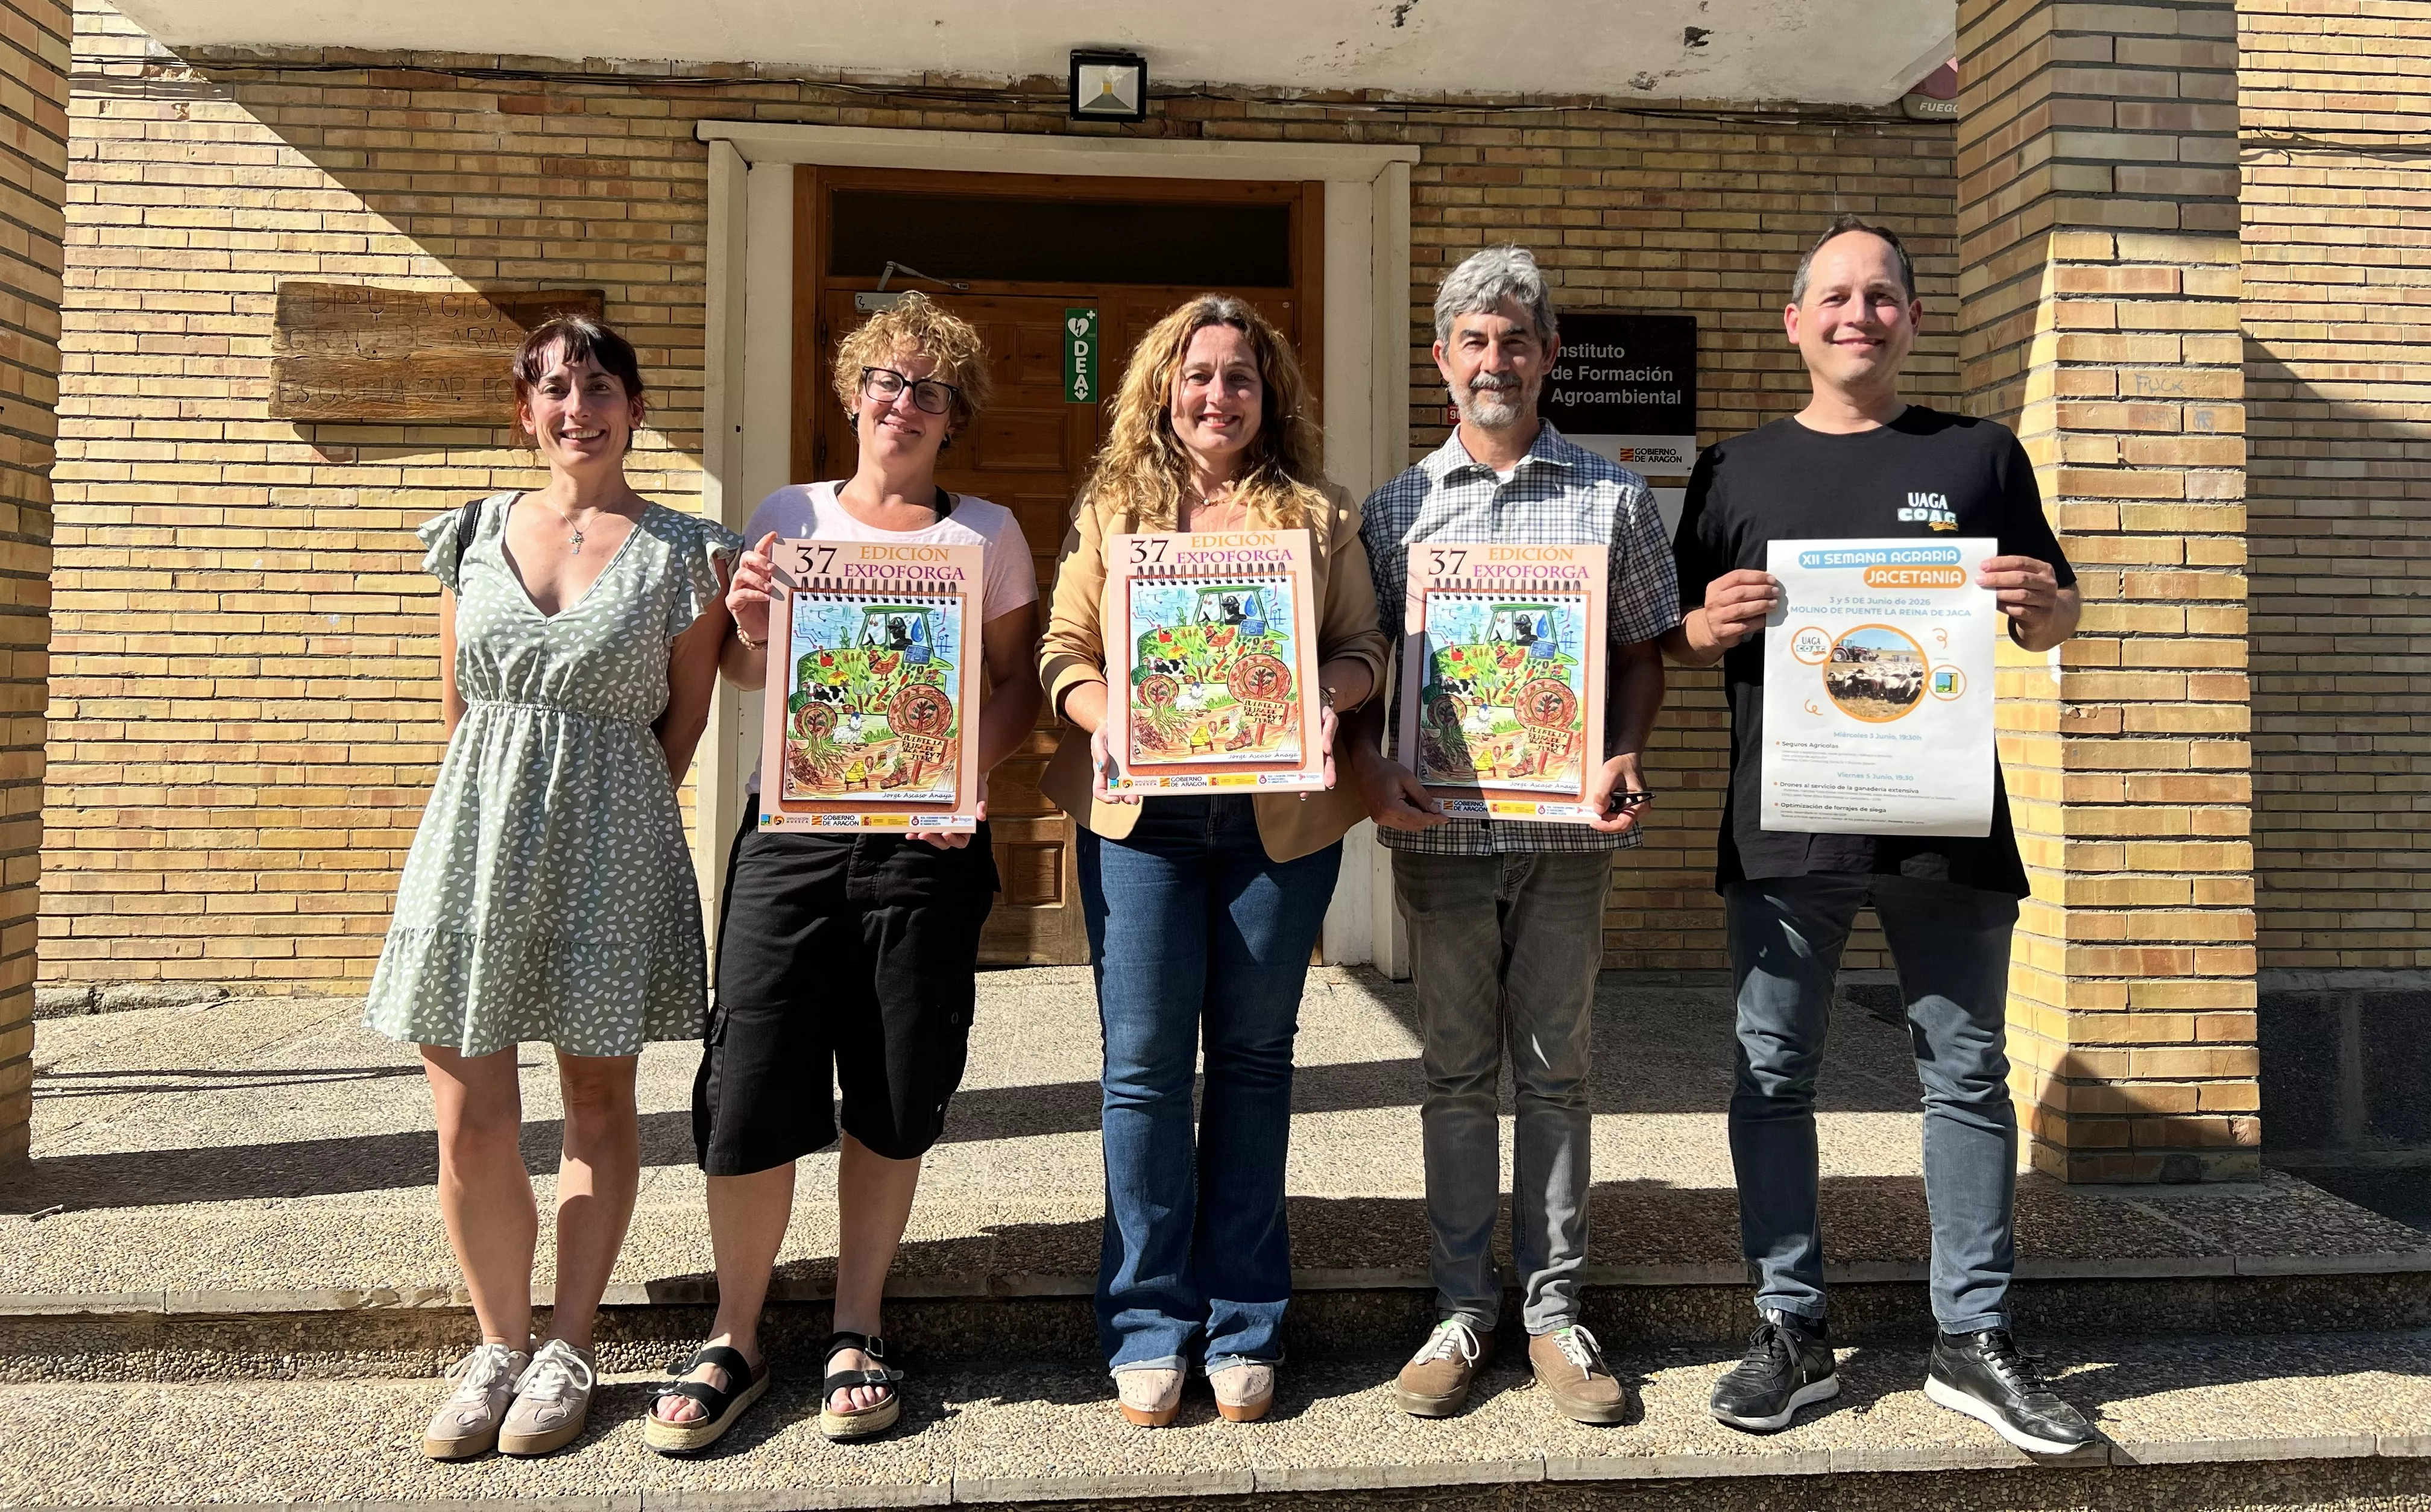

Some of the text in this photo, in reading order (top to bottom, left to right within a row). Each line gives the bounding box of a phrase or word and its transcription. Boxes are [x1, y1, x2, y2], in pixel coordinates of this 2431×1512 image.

[312, 288, 517, 323] DIPUTACION
[396, 324, 433, 347] DE
[451, 327, 528, 350] ARAG
[1557, 343, 1625, 358] nstituto
[1073, 340, 1089, 391] DEA
[1551, 366, 1673, 382] de Formación
[2134, 373, 2186, 395] FUCK
[1551, 388, 1681, 406] Agroambiental
[1908, 492, 1948, 510] UAGA
[1130, 532, 1276, 564] 37 EDICIÓN
[1176, 549, 1293, 564] EXPOFORGA
[794, 544, 950, 575] 37 EDICIÓN
[1428, 546, 1574, 576] 37 EDICIÓN
[1802, 550, 1957, 565] XII SEMANA AGRARIA
[843, 563, 966, 581] EXPOFORGA
[1473, 564, 1590, 579] EXPOFORGA
[1867, 570, 1962, 584] JACETANIA
